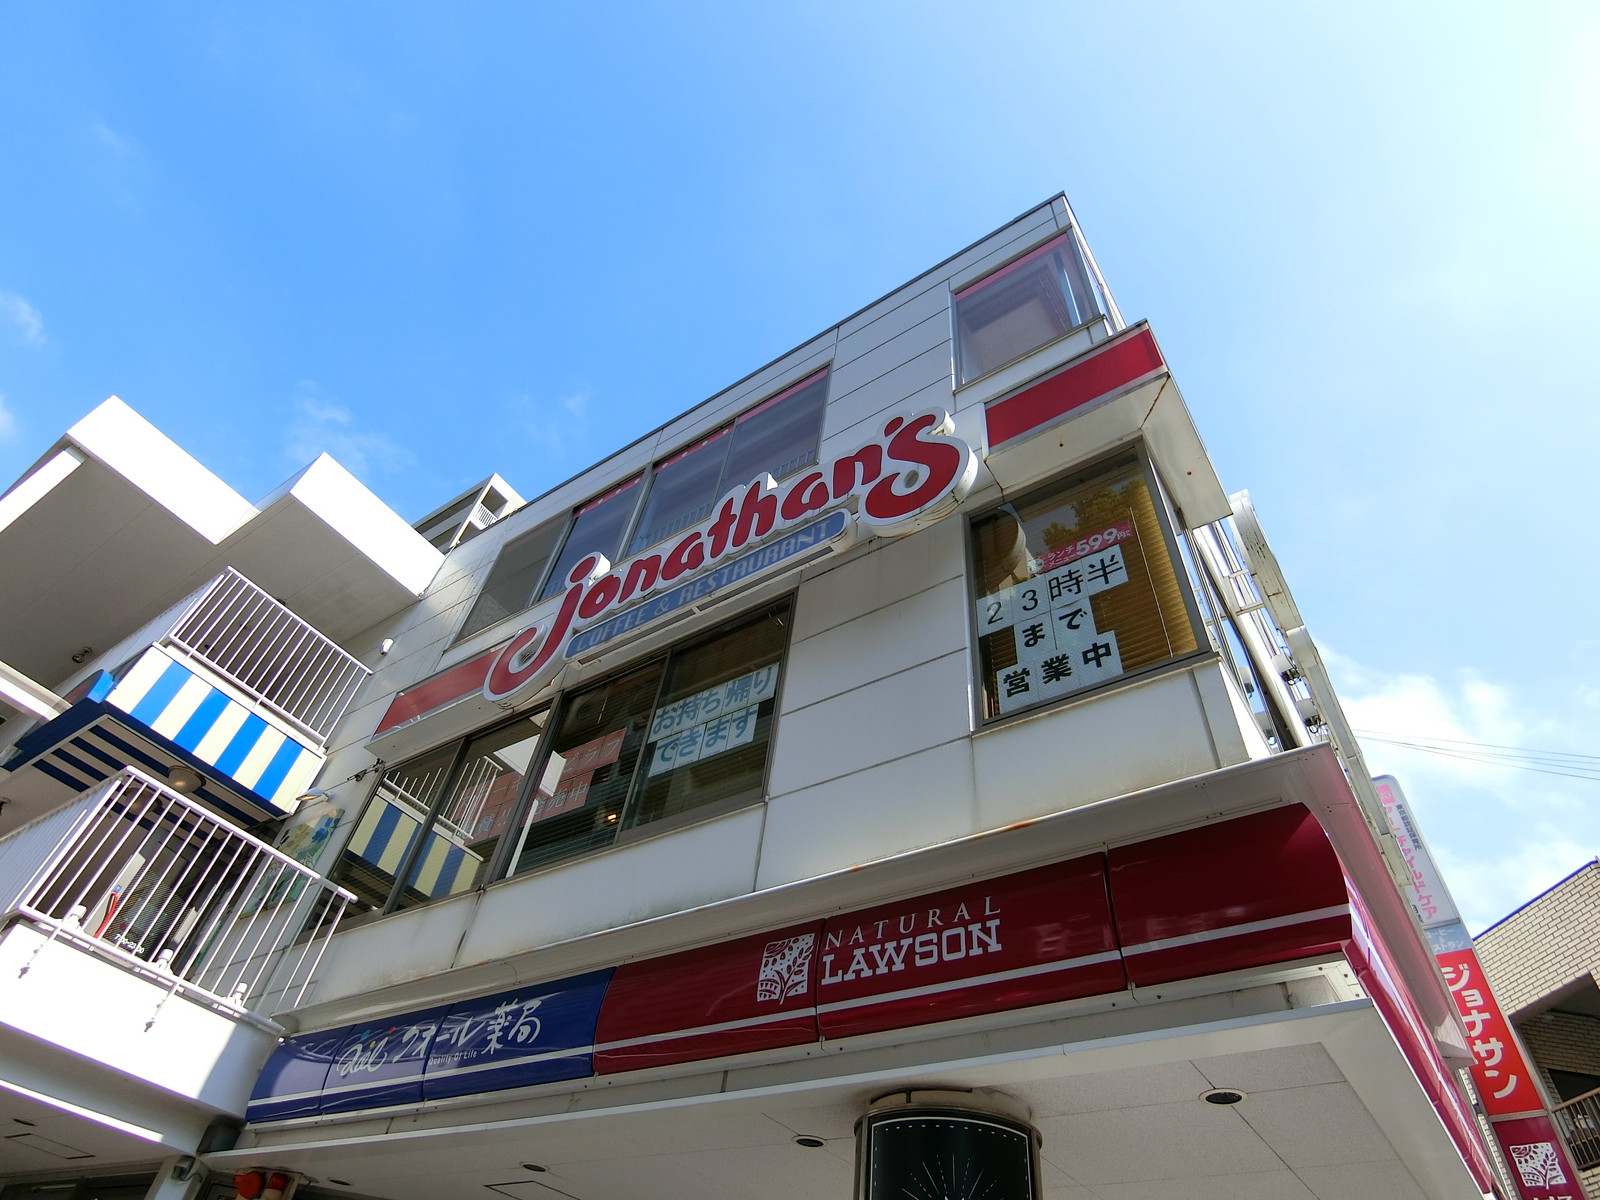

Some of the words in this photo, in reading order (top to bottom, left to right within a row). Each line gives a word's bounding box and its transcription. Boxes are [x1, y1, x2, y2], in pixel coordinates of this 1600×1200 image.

[489, 414, 961, 694] jonathan's
[1047, 544, 1075, 561] ランチ
[576, 606, 645, 652] COFFEE
[654, 598, 671, 615] &
[679, 522, 831, 606] RESTAURANT
[1023, 608, 1087, 648] まで
[1003, 643, 1112, 698] 営業中
[653, 666, 772, 735] お持ち帰り
[657, 709, 757, 762] できます
[824, 896, 1001, 950] NATURAL
[1432, 940, 1464, 953] ストラン
[821, 919, 1002, 985] LAWSON
[394, 999, 543, 1063] クオール薬局
[428, 1053, 453, 1066] Quality
[454, 1052, 464, 1062] Of
[464, 1050, 478, 1060] Life
[1442, 965, 1517, 1099] ジョナサン
